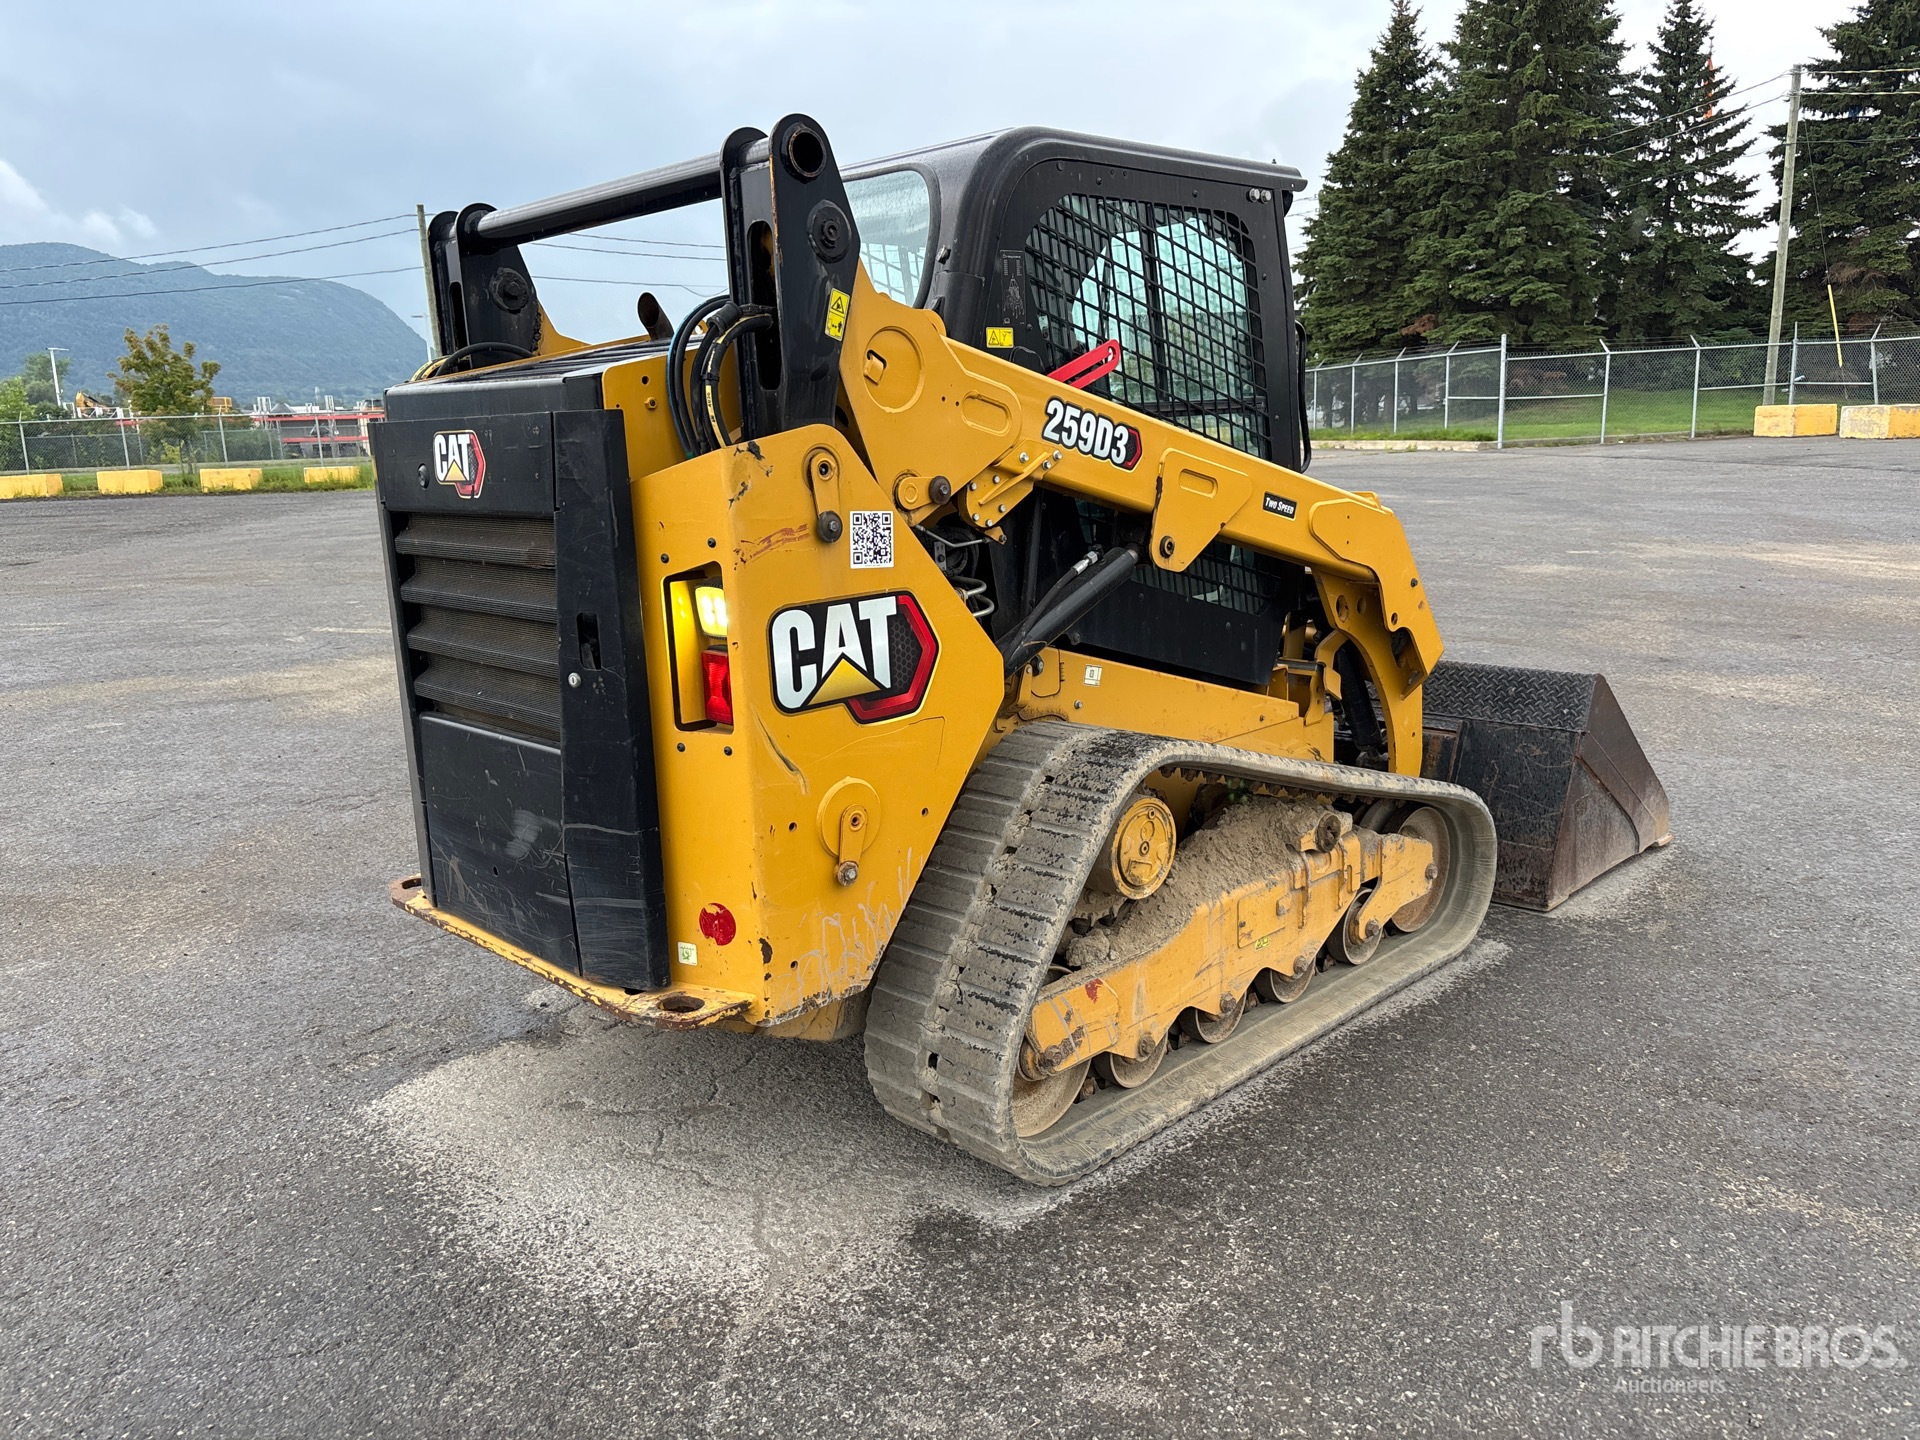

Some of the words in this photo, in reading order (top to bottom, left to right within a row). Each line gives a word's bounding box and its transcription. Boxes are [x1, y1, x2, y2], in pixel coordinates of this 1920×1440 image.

[434, 433, 470, 482] CAT
[1043, 399, 1129, 464] 259D3
[772, 596, 897, 709] CAT
